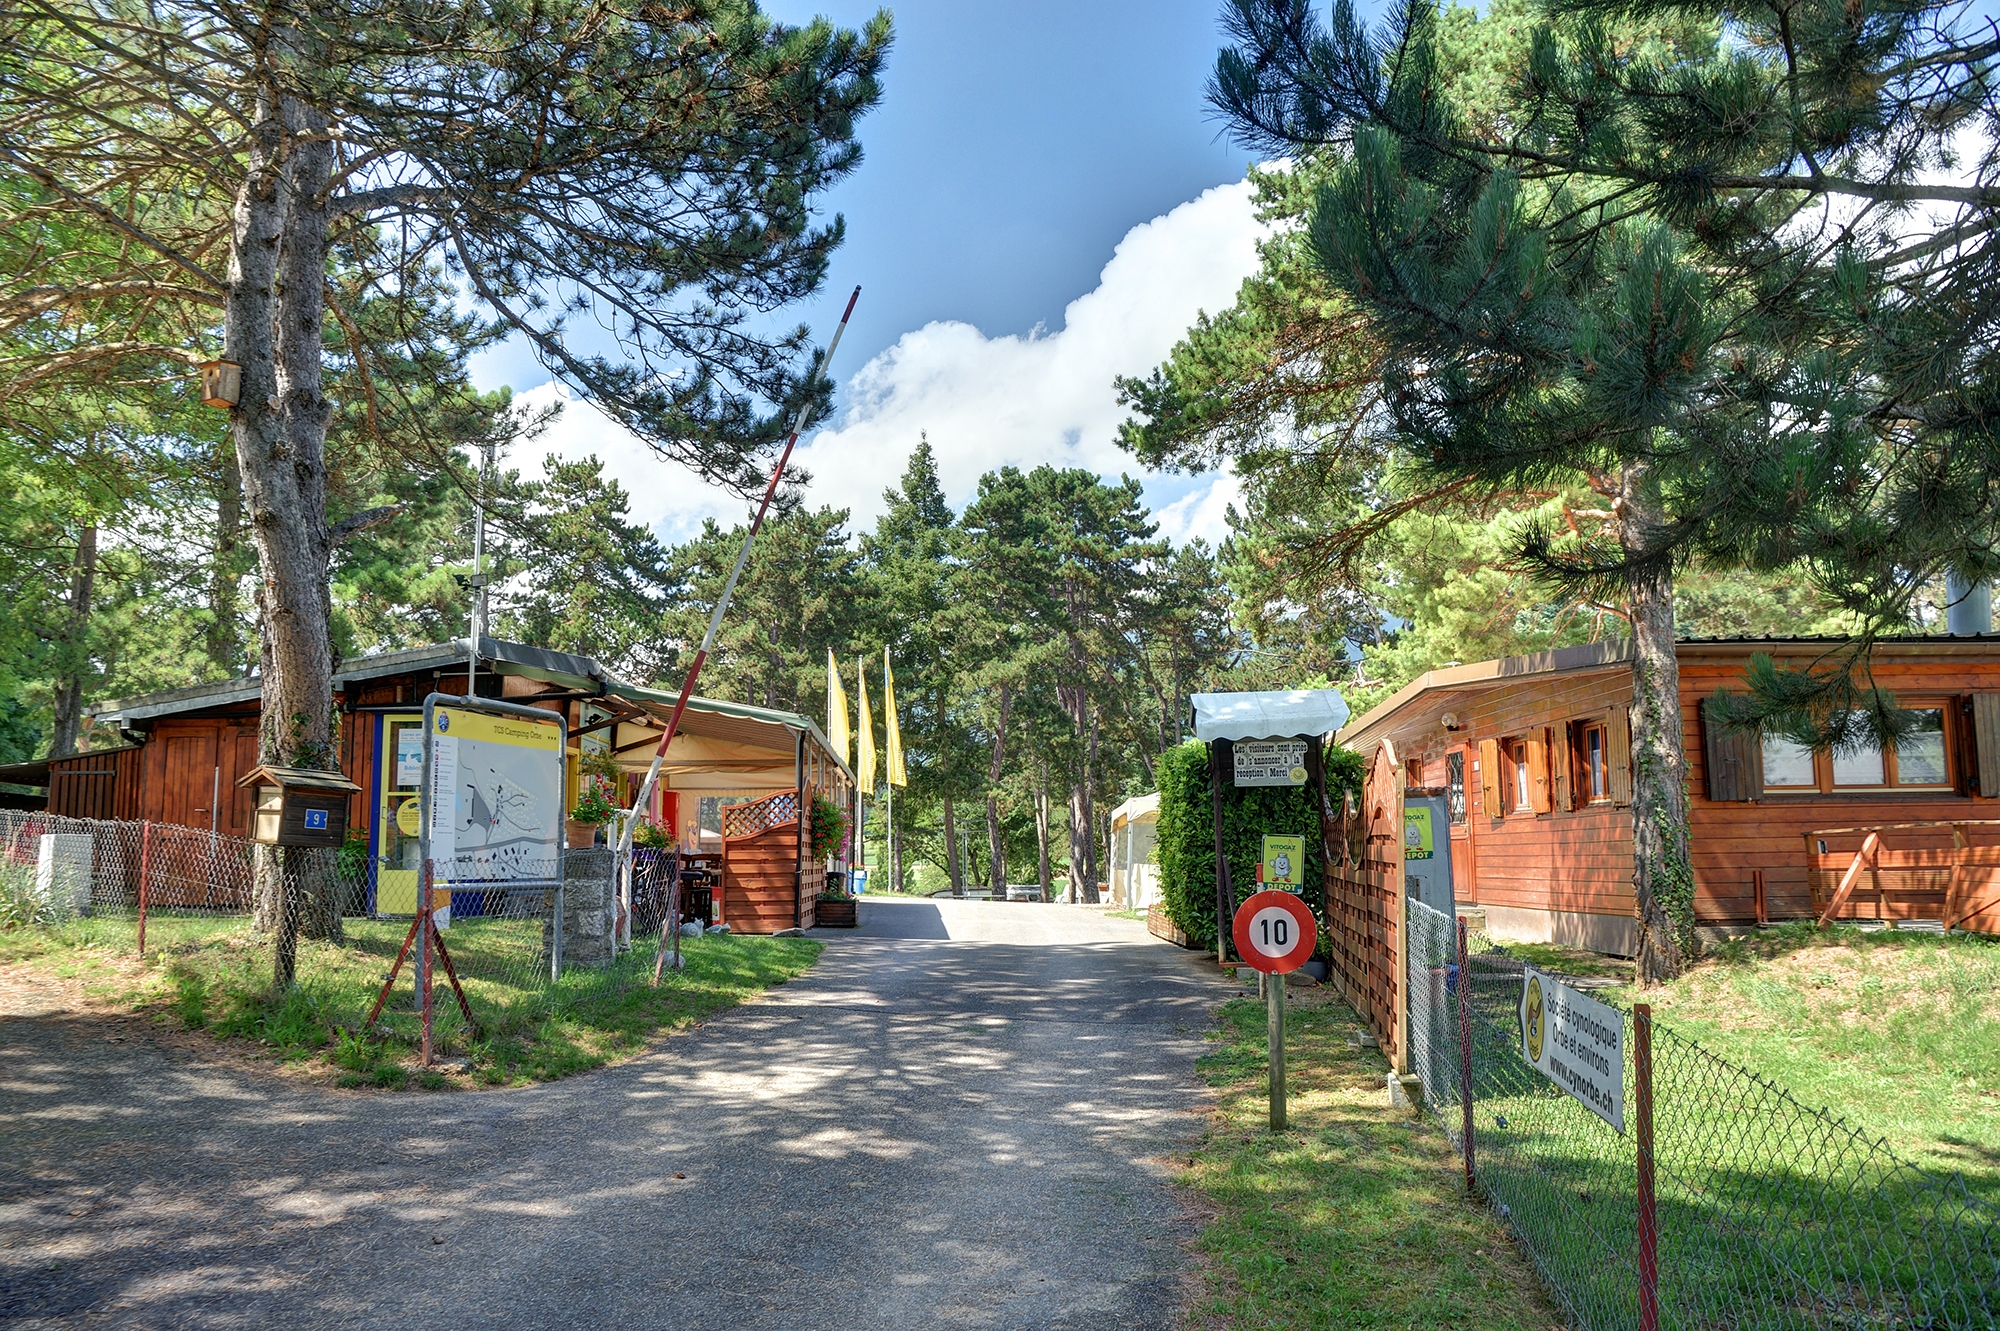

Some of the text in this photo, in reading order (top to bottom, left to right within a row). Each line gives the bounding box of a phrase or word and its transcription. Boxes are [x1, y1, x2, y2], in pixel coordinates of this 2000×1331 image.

[494, 725, 542, 740] TCS Camping Orbe
[1234, 744, 1245, 754] Les
[1248, 743, 1275, 753] visiteurs
[1277, 743, 1290, 752] sont
[1237, 756, 1245, 766] de
[1248, 755, 1281, 765] s'annoncer
[1293, 755, 1300, 764] la
[1269, 767, 1288, 778] Merci
[313, 814, 320, 825] 9
[1261, 919, 1288, 946] 10
[1547, 992, 1617, 1050] Société cynologique
[1552, 1022, 1610, 1077] Orbe et environs
[1550, 1055, 1614, 1115] www.cynorbe.ch
